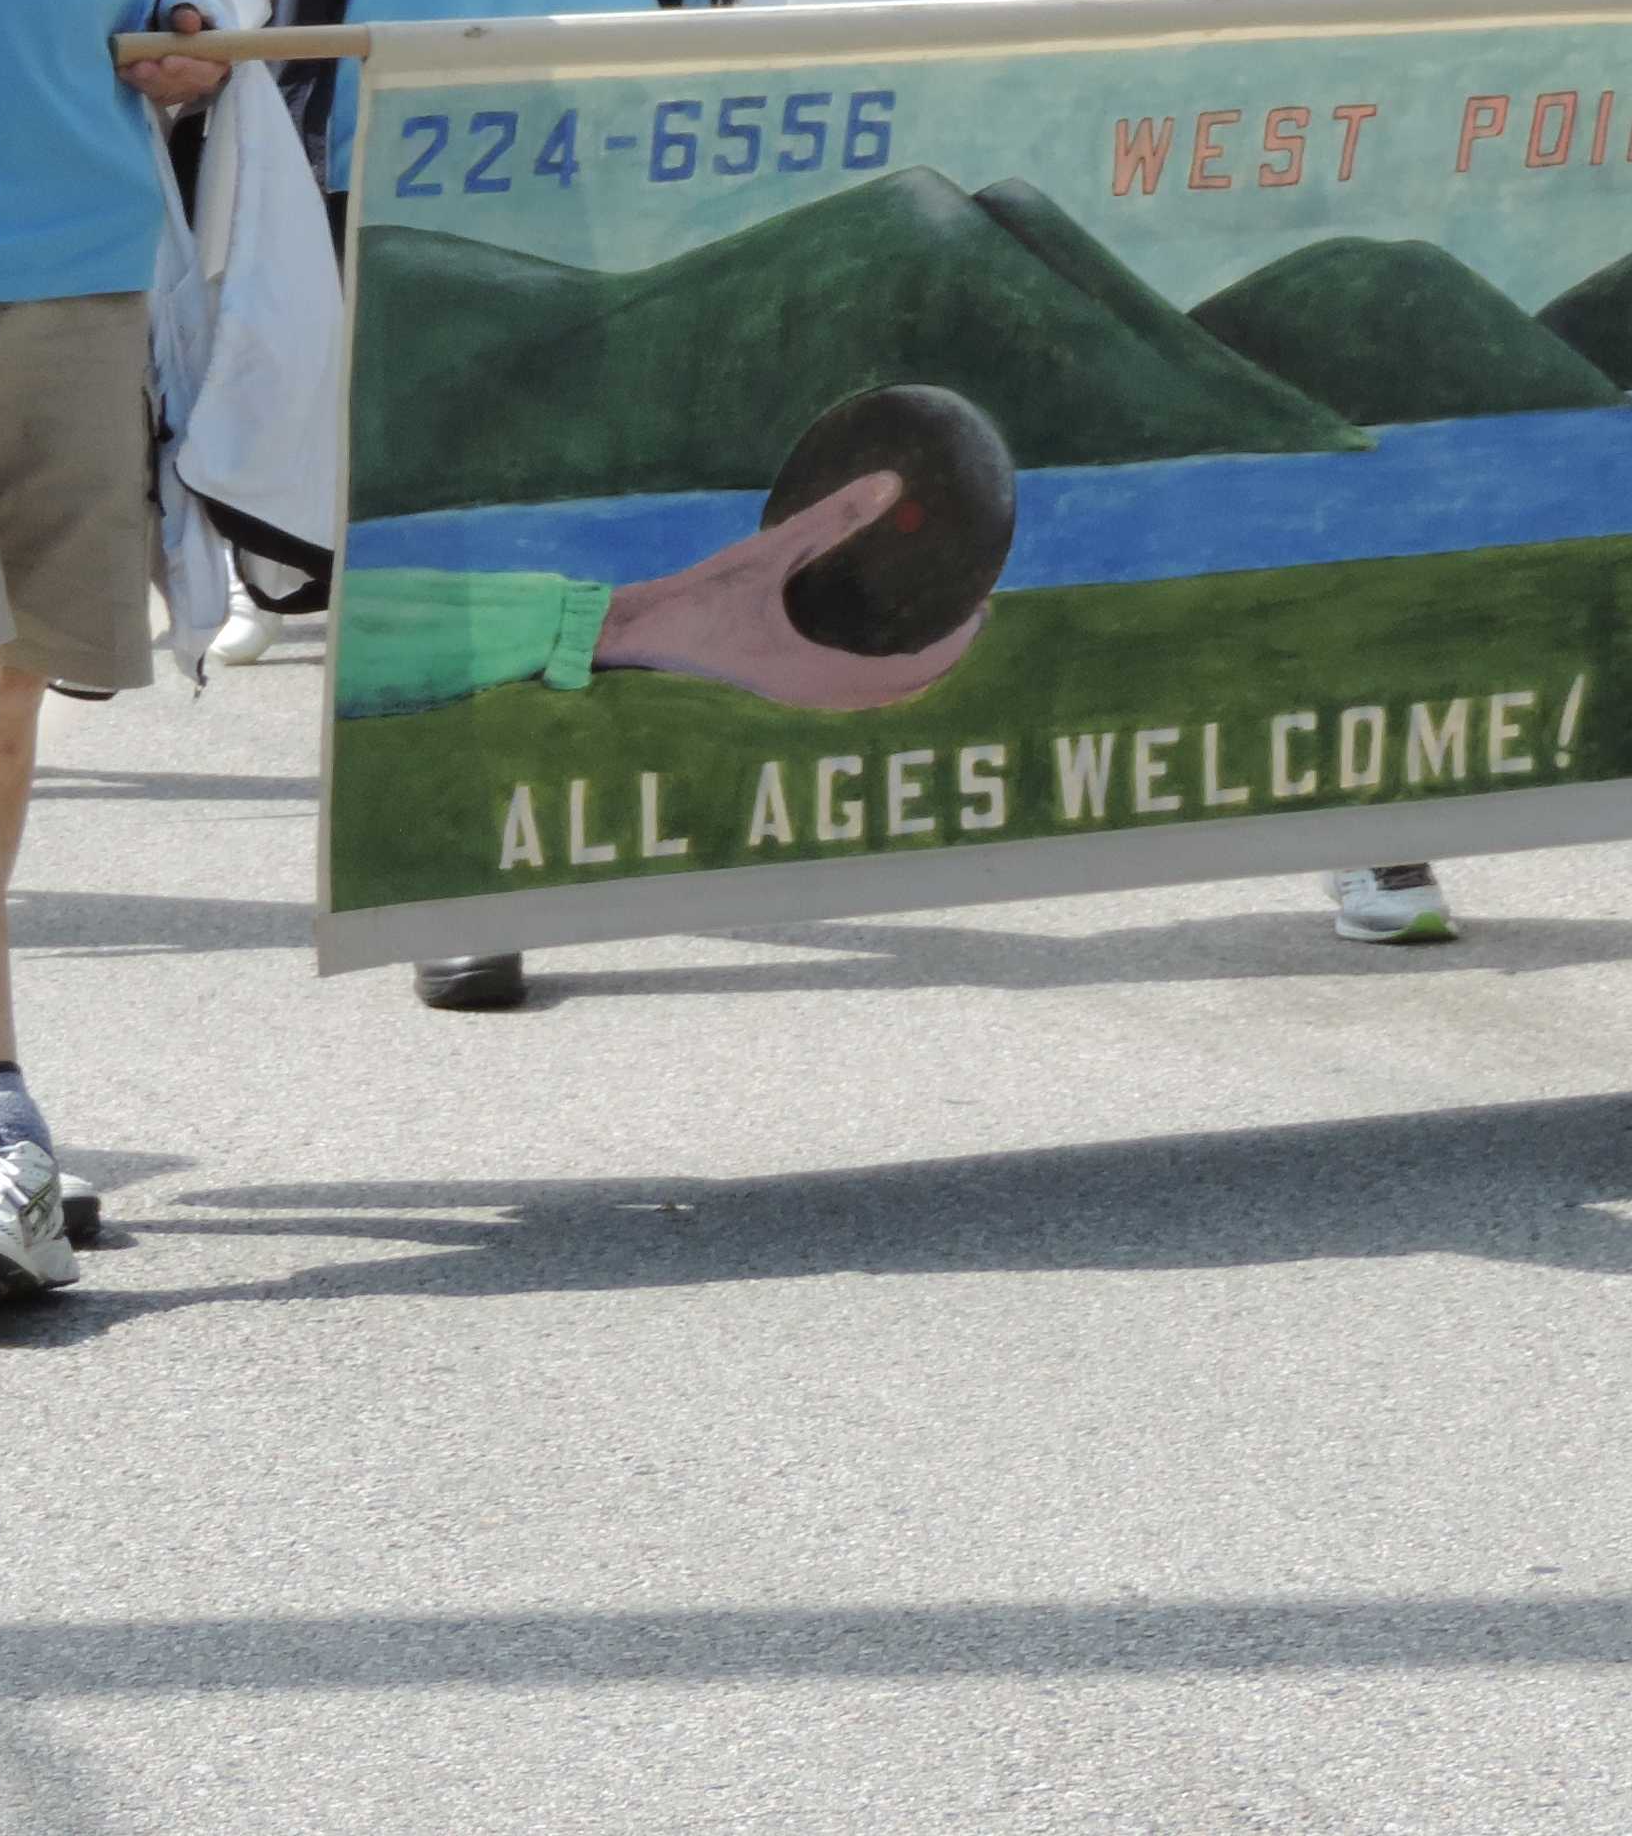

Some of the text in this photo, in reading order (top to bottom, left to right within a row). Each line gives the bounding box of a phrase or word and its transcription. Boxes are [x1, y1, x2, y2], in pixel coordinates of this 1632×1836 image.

[394, 90, 897, 198] 224-6556
[1111, 103, 1377, 197] WEST
[498, 675, 1587, 872] ALL AGES WELCOME!
